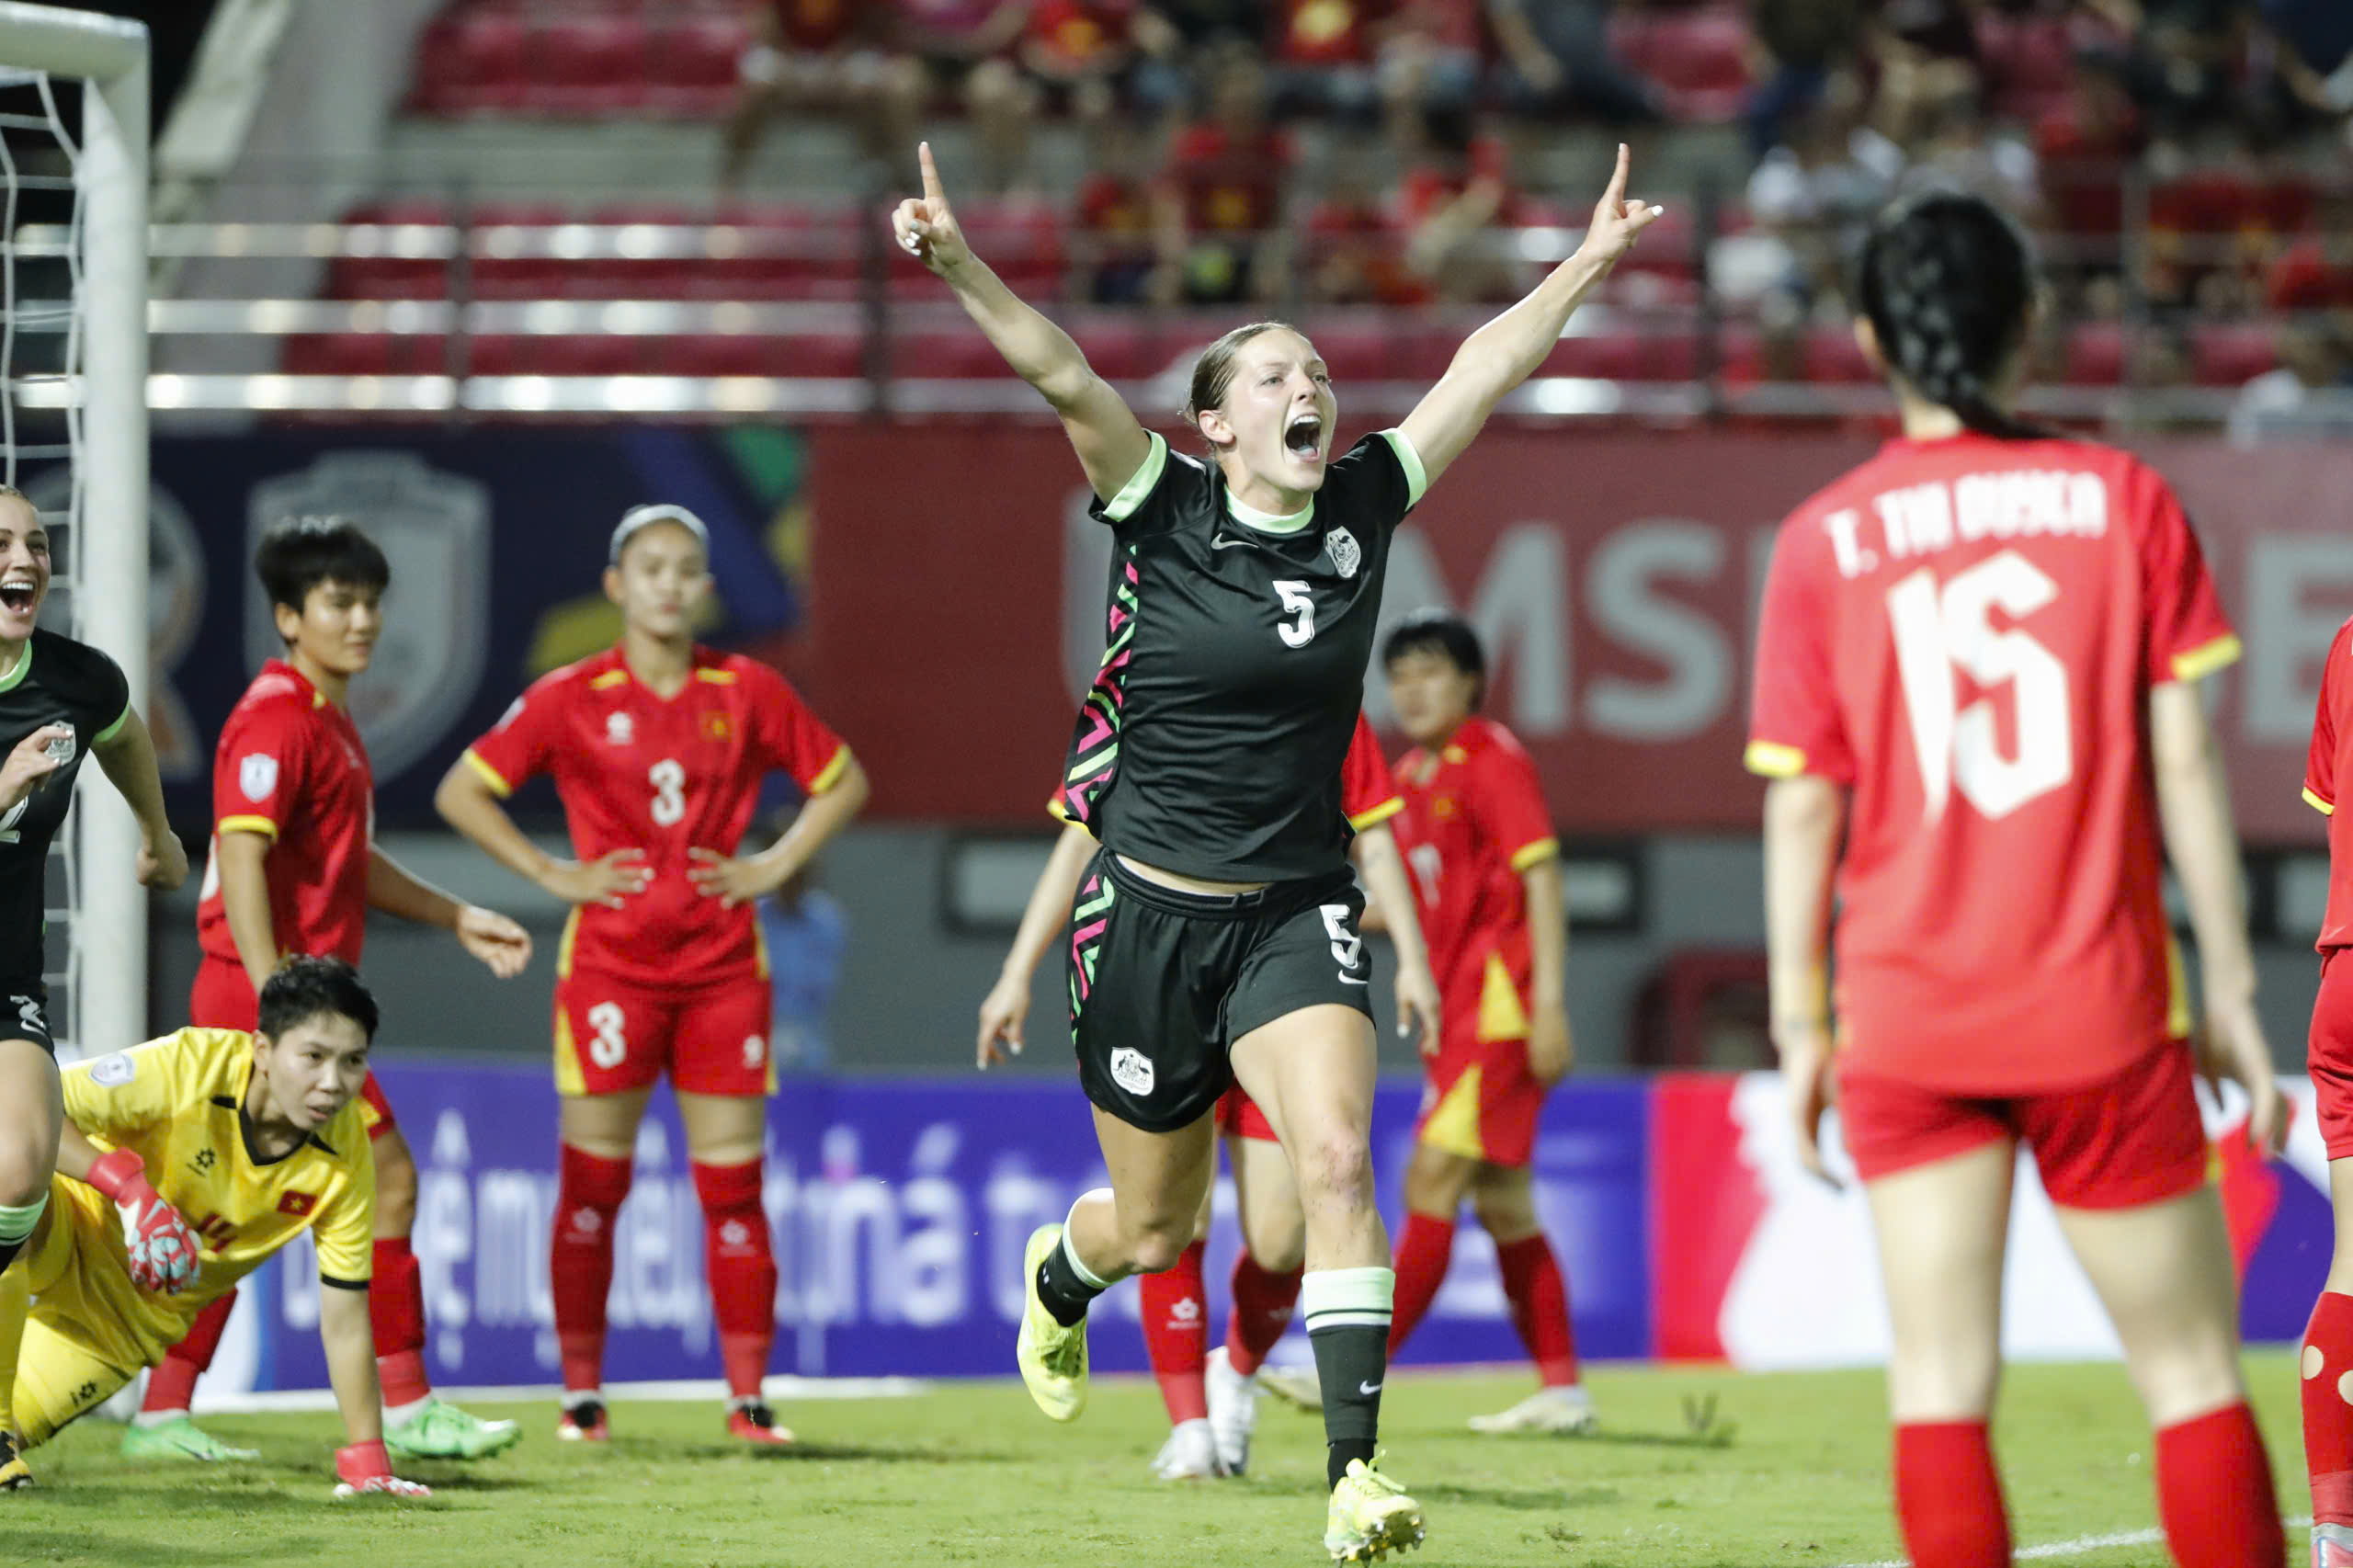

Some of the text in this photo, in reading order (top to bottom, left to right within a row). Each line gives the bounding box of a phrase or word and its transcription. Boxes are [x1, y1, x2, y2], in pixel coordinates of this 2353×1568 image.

[1272, 580, 1315, 649] 5
[1885, 549, 2074, 825] 15
[648, 758, 686, 826] 3
[1319, 904, 1362, 970] 5
[587, 1001, 627, 1068] 3
